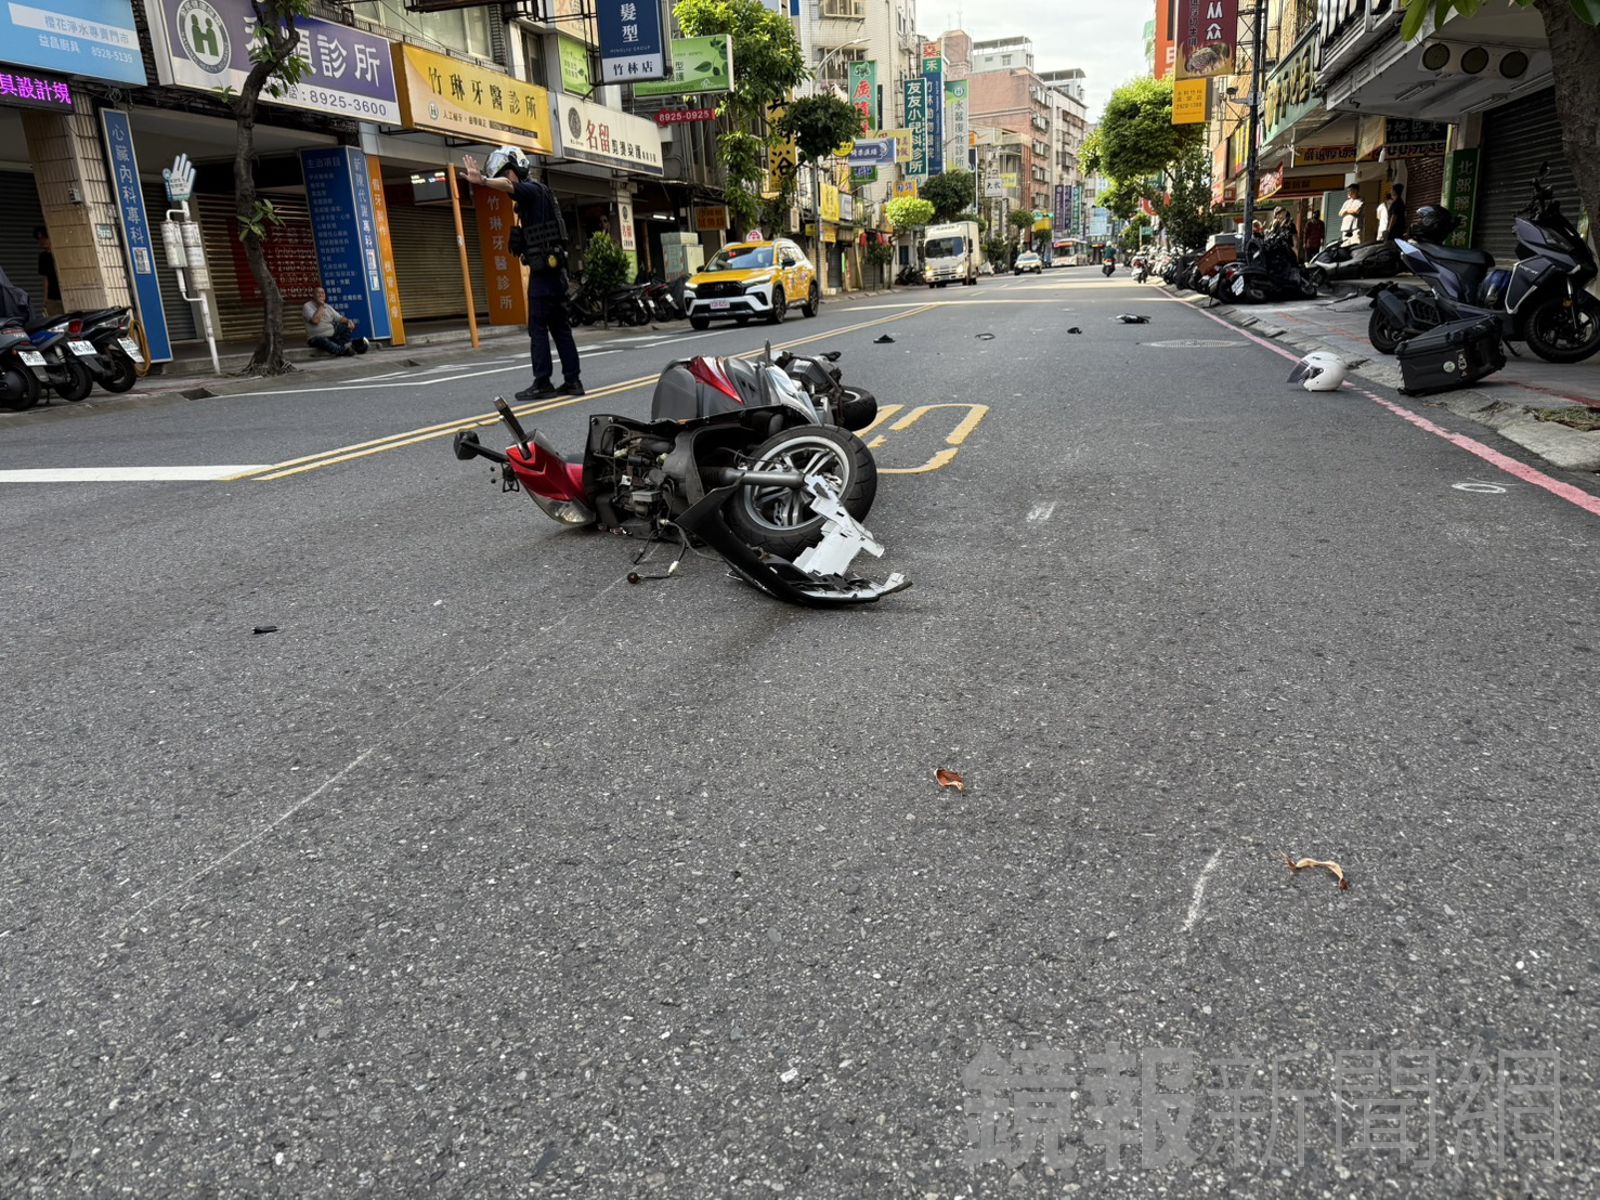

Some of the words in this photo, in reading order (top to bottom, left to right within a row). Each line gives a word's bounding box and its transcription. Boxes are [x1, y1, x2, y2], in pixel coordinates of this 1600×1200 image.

[620, 3, 639, 43] 髮型
[613, 61, 653, 77] 竹林店
[428, 66, 537, 120] 竹琳牙醫診所
[659, 110, 710, 122] 8925-0925
[486, 195, 513, 311] 竹琳牙醫診所
